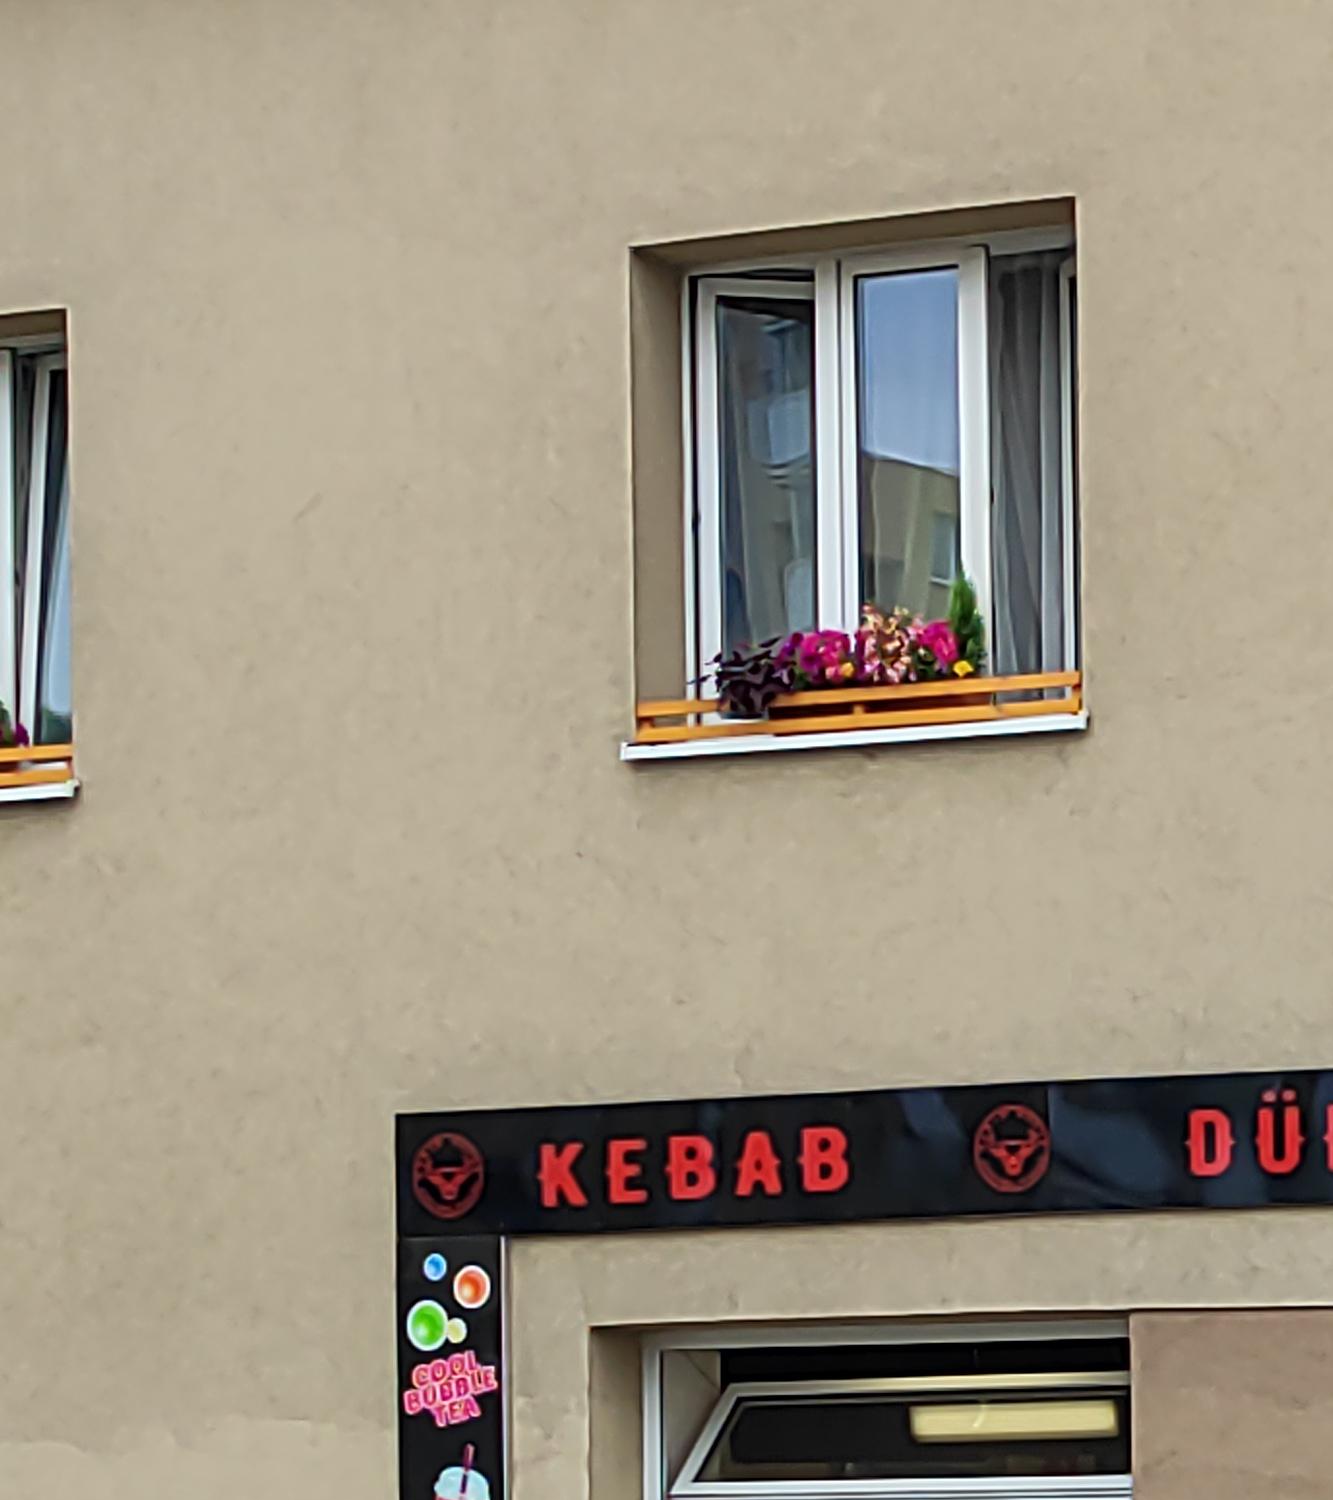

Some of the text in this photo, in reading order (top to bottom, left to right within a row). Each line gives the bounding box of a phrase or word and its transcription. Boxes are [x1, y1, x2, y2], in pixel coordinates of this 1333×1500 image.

[539, 1127, 850, 1207] KEBAB
[403, 1366, 498, 1415] BUBBLE
[412, 1350, 477, 1389] COOL
[432, 1396, 481, 1427] TEA
